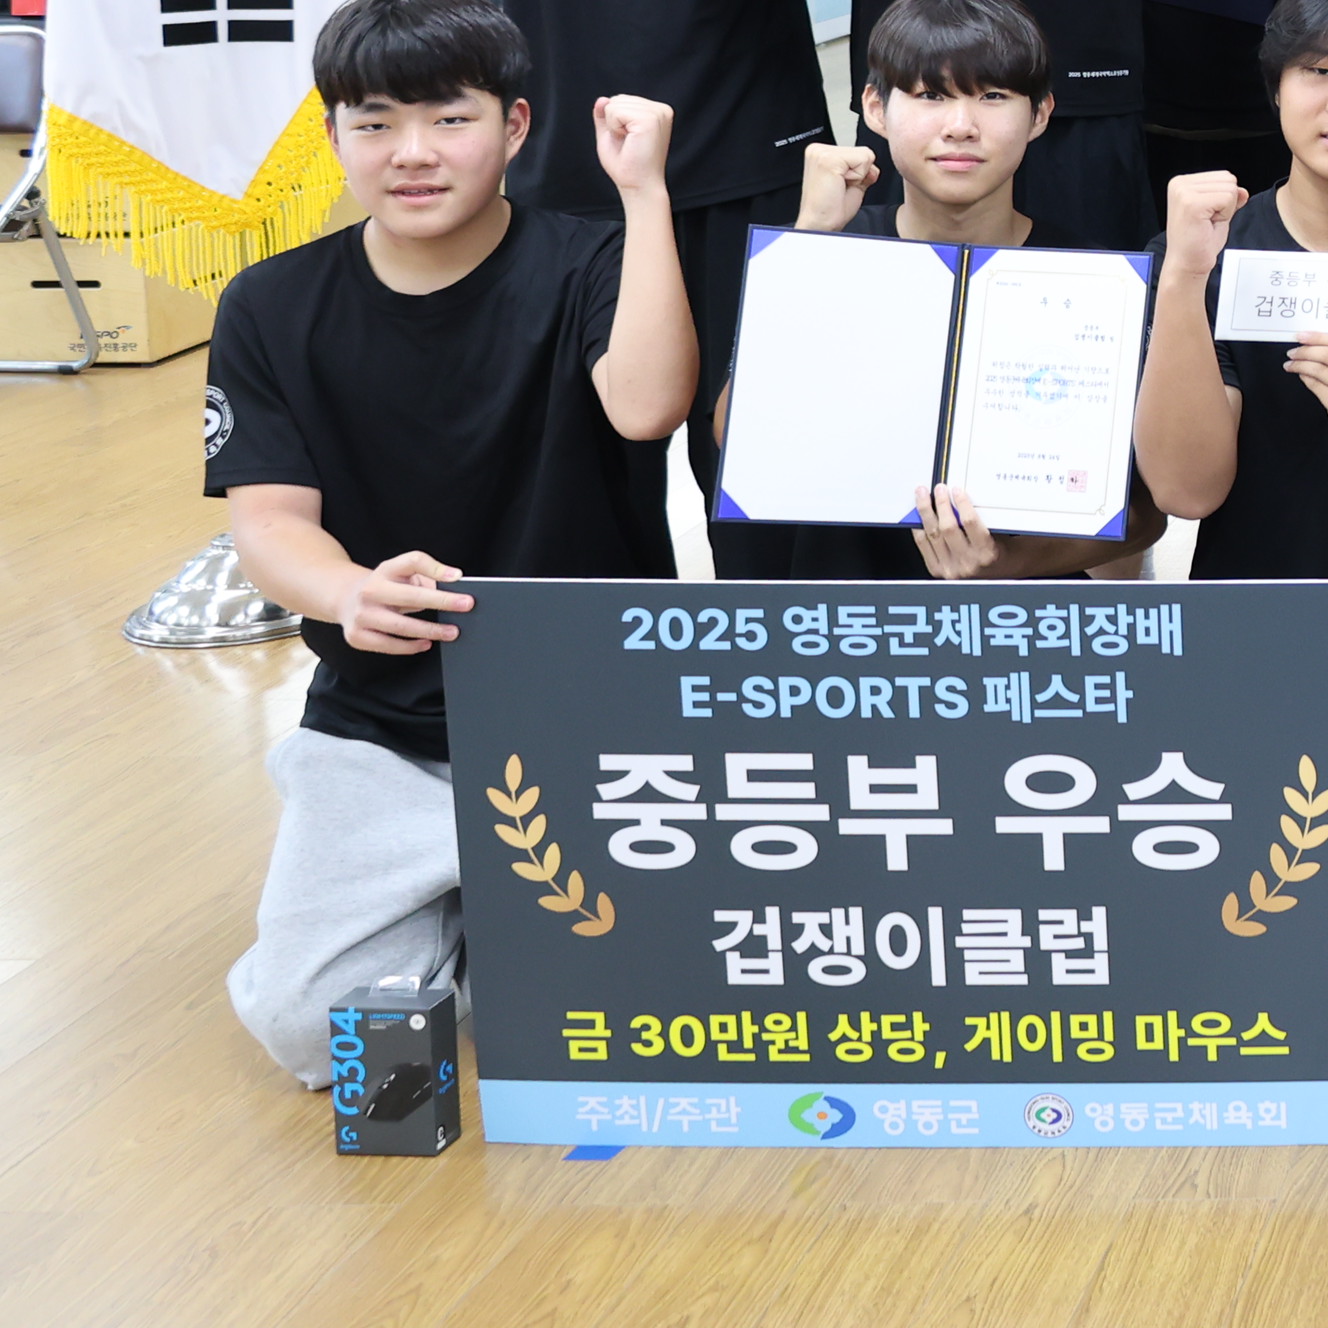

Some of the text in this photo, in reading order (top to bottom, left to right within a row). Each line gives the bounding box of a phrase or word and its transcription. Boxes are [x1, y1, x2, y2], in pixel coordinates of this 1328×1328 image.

[1269, 270, 1318, 287] 중등부
[68, 343, 138, 352] 국민진흥공단
[622, 604, 1182, 656] 2025 영동군체육회장배
[681, 672, 1133, 723] E-SPORTS 페스타
[593, 752, 1232, 870] 중등부 우승
[712, 906, 1109, 986] 겁쟁이클럽
[329, 1007, 366, 1115] G304
[563, 1011, 1289, 1068] 금 30만원 상당, 게이밍 마우스
[576, 1095, 741, 1132] 주최/주관
[873, 1100, 979, 1135] 영동군
[1085, 1100, 1287, 1132] 영동군체육회
